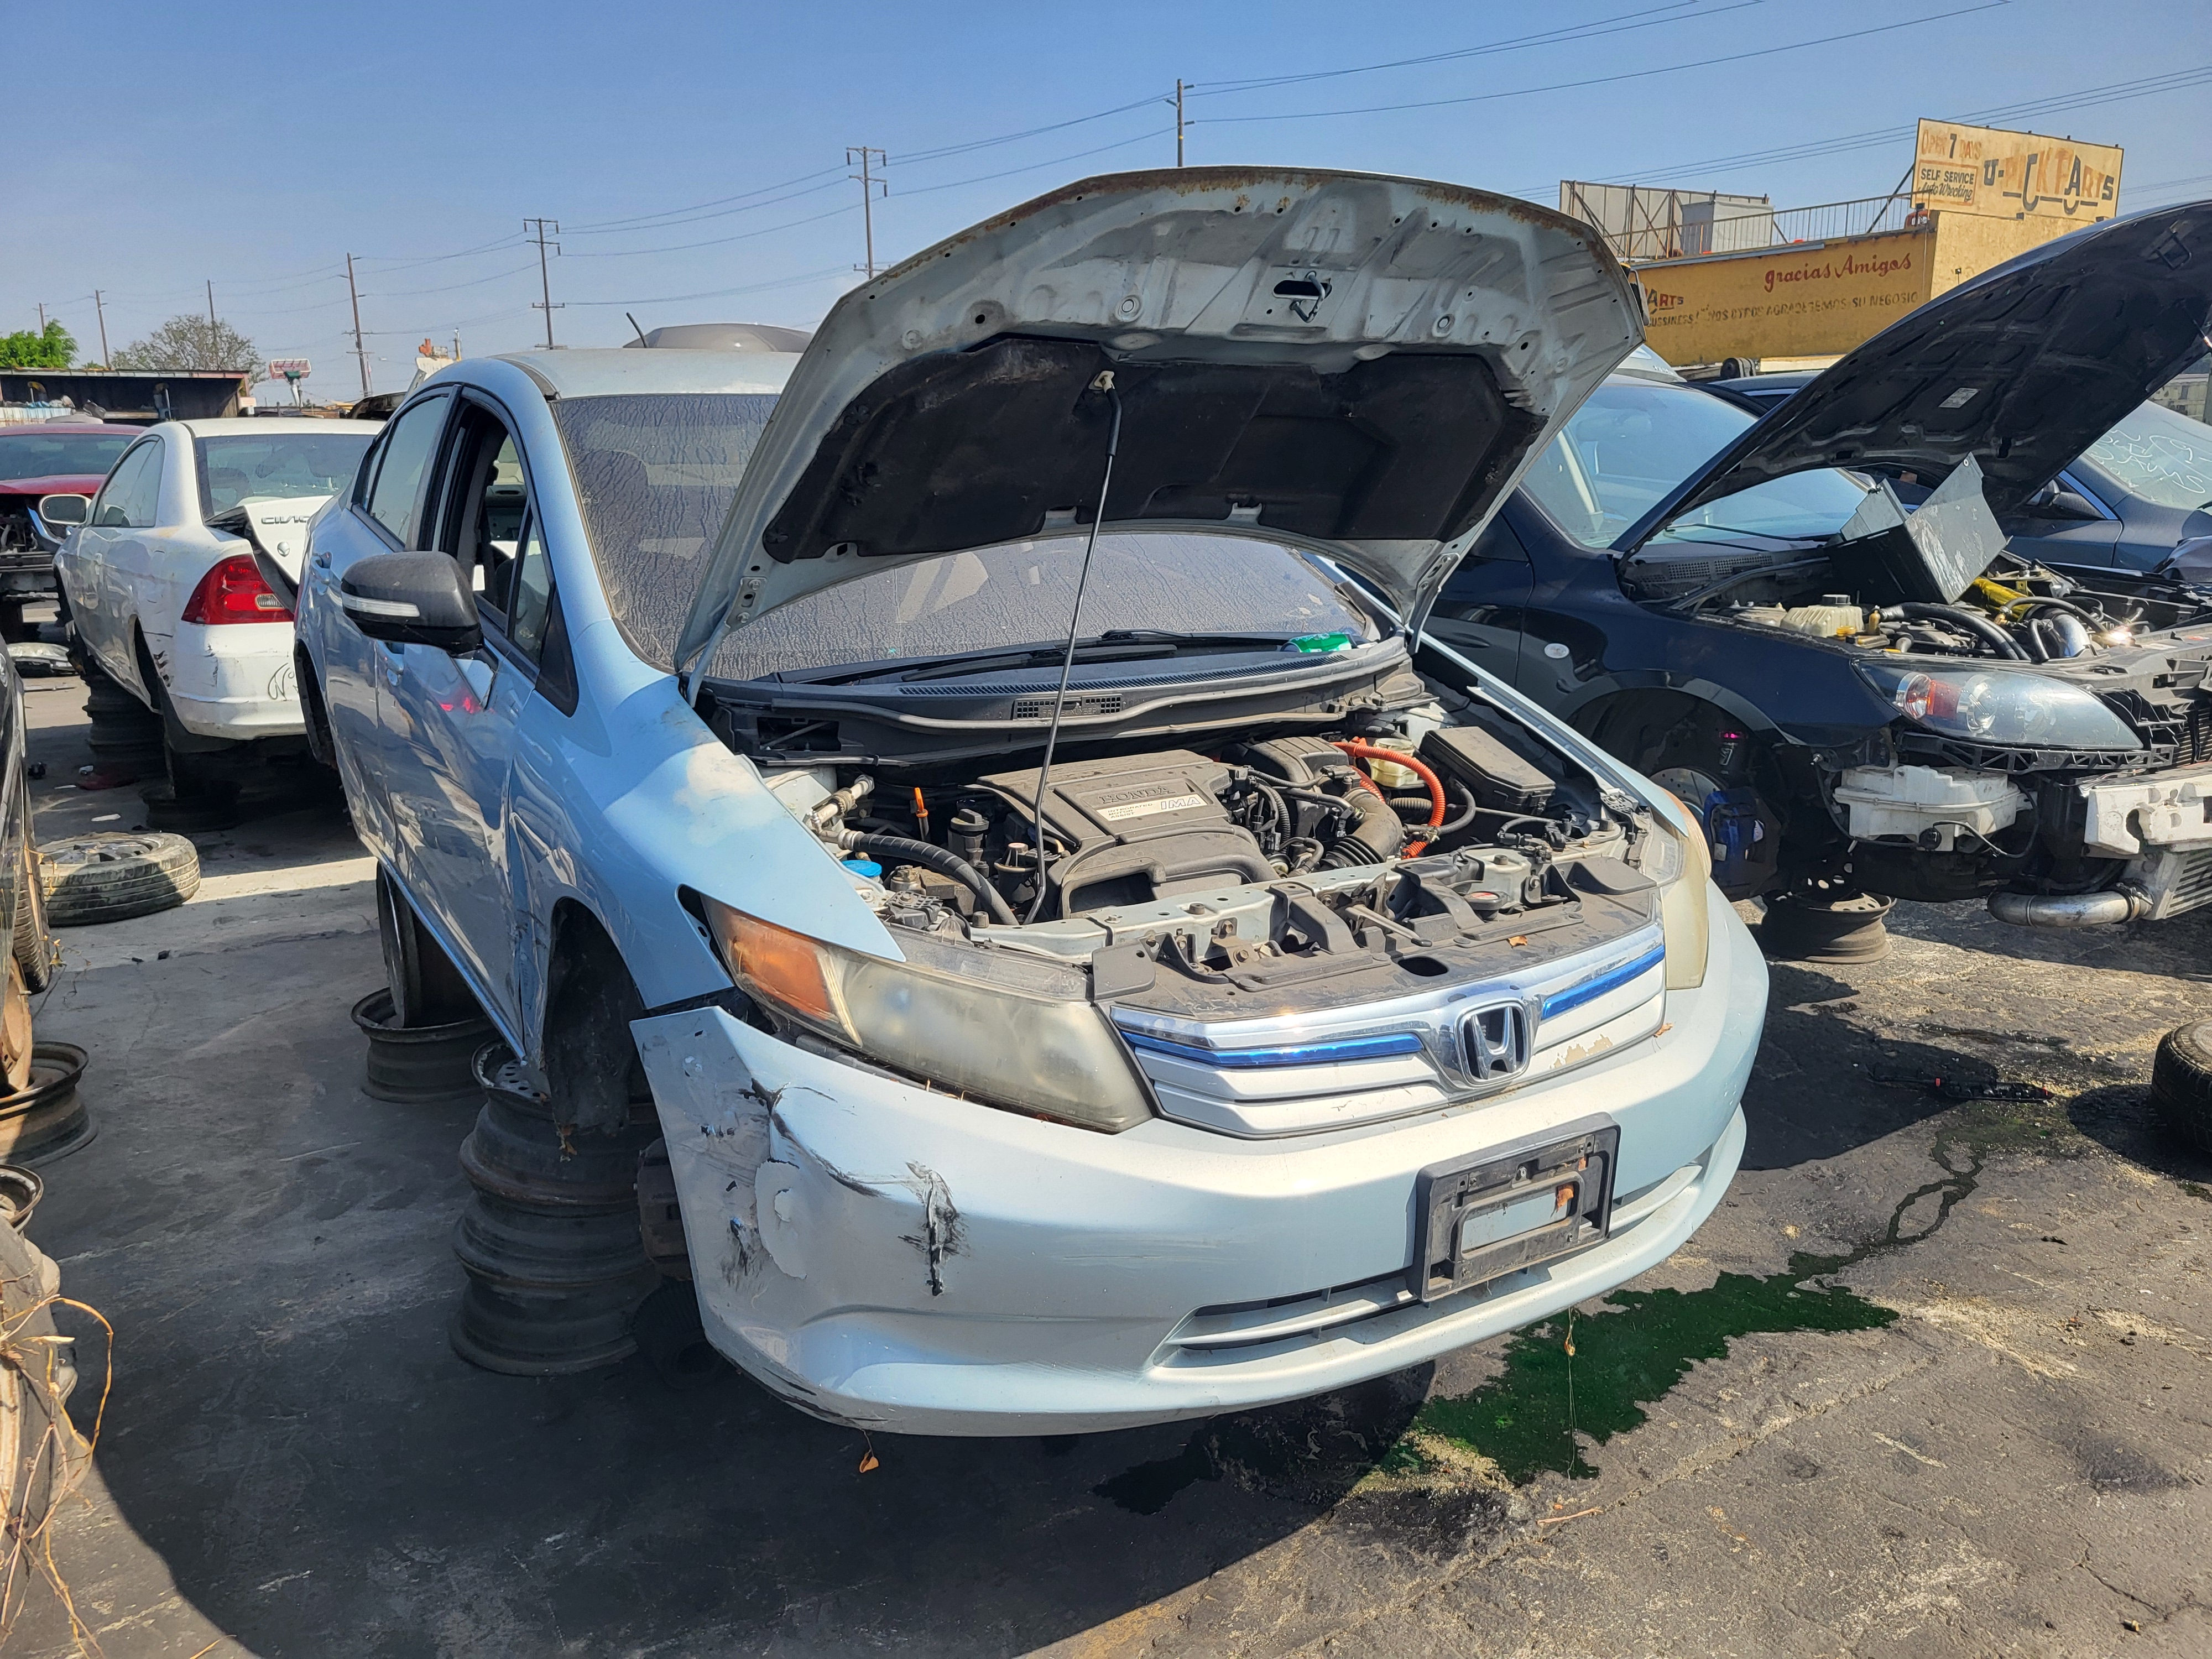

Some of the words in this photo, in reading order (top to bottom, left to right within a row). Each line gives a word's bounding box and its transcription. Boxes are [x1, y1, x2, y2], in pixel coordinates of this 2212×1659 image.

[1949, 133, 1957, 159] 7
[1959, 139, 1982, 160] DAYS
[1921, 168, 1941, 181] SELF
[1944, 170, 1974, 185] SERVICE
[2054, 147, 2114, 202] PARTS
[1938, 183, 1973, 202] Wrecking
[1835, 253, 1911, 278] Amigos
[1645, 288, 1683, 307] ARTS
[1853, 297, 1866, 307] SU
[1870, 291, 1917, 306] NEGOSIO
[261, 515, 310, 524] CIVIC
[1099, 785, 1176, 804] HONDA
[1161, 797, 1201, 810] IMA
[1108, 803, 1153, 813] INTEGRATED
